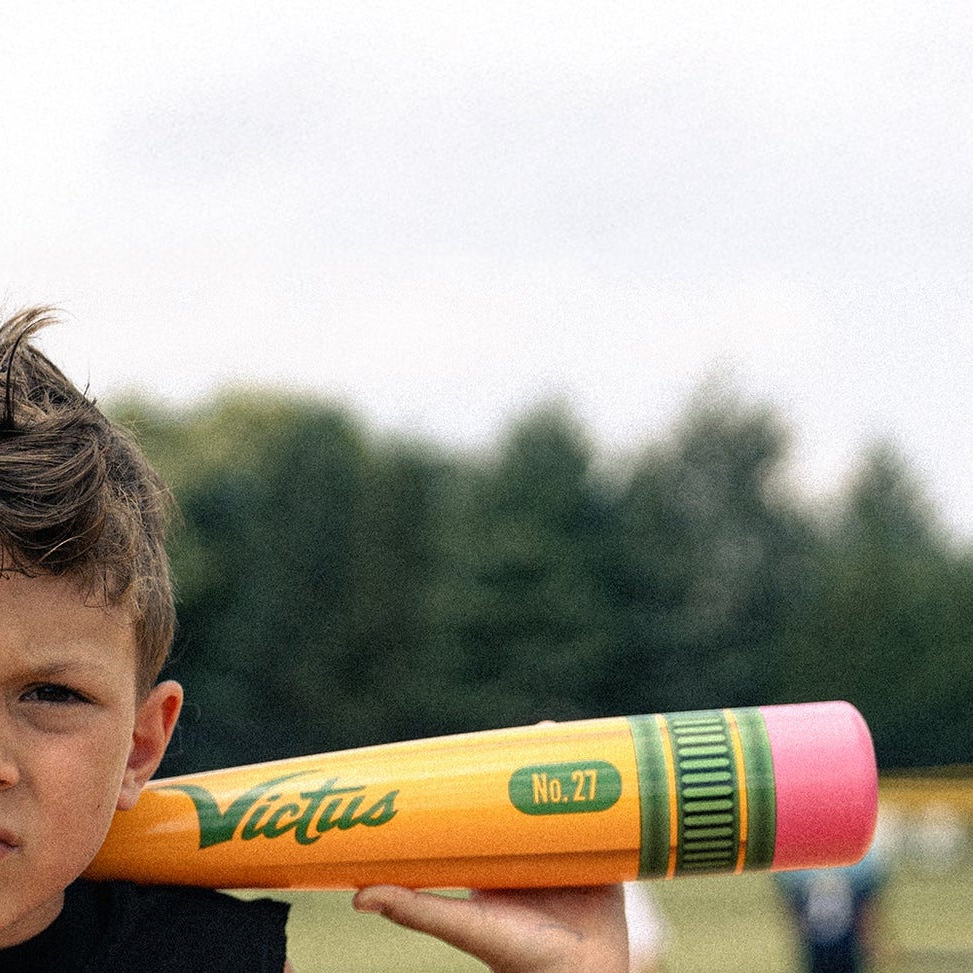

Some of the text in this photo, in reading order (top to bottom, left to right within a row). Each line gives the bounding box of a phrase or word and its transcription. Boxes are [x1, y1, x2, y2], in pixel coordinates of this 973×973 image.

[153, 769, 400, 849] Victus
[531, 768, 598, 805] No. 27
